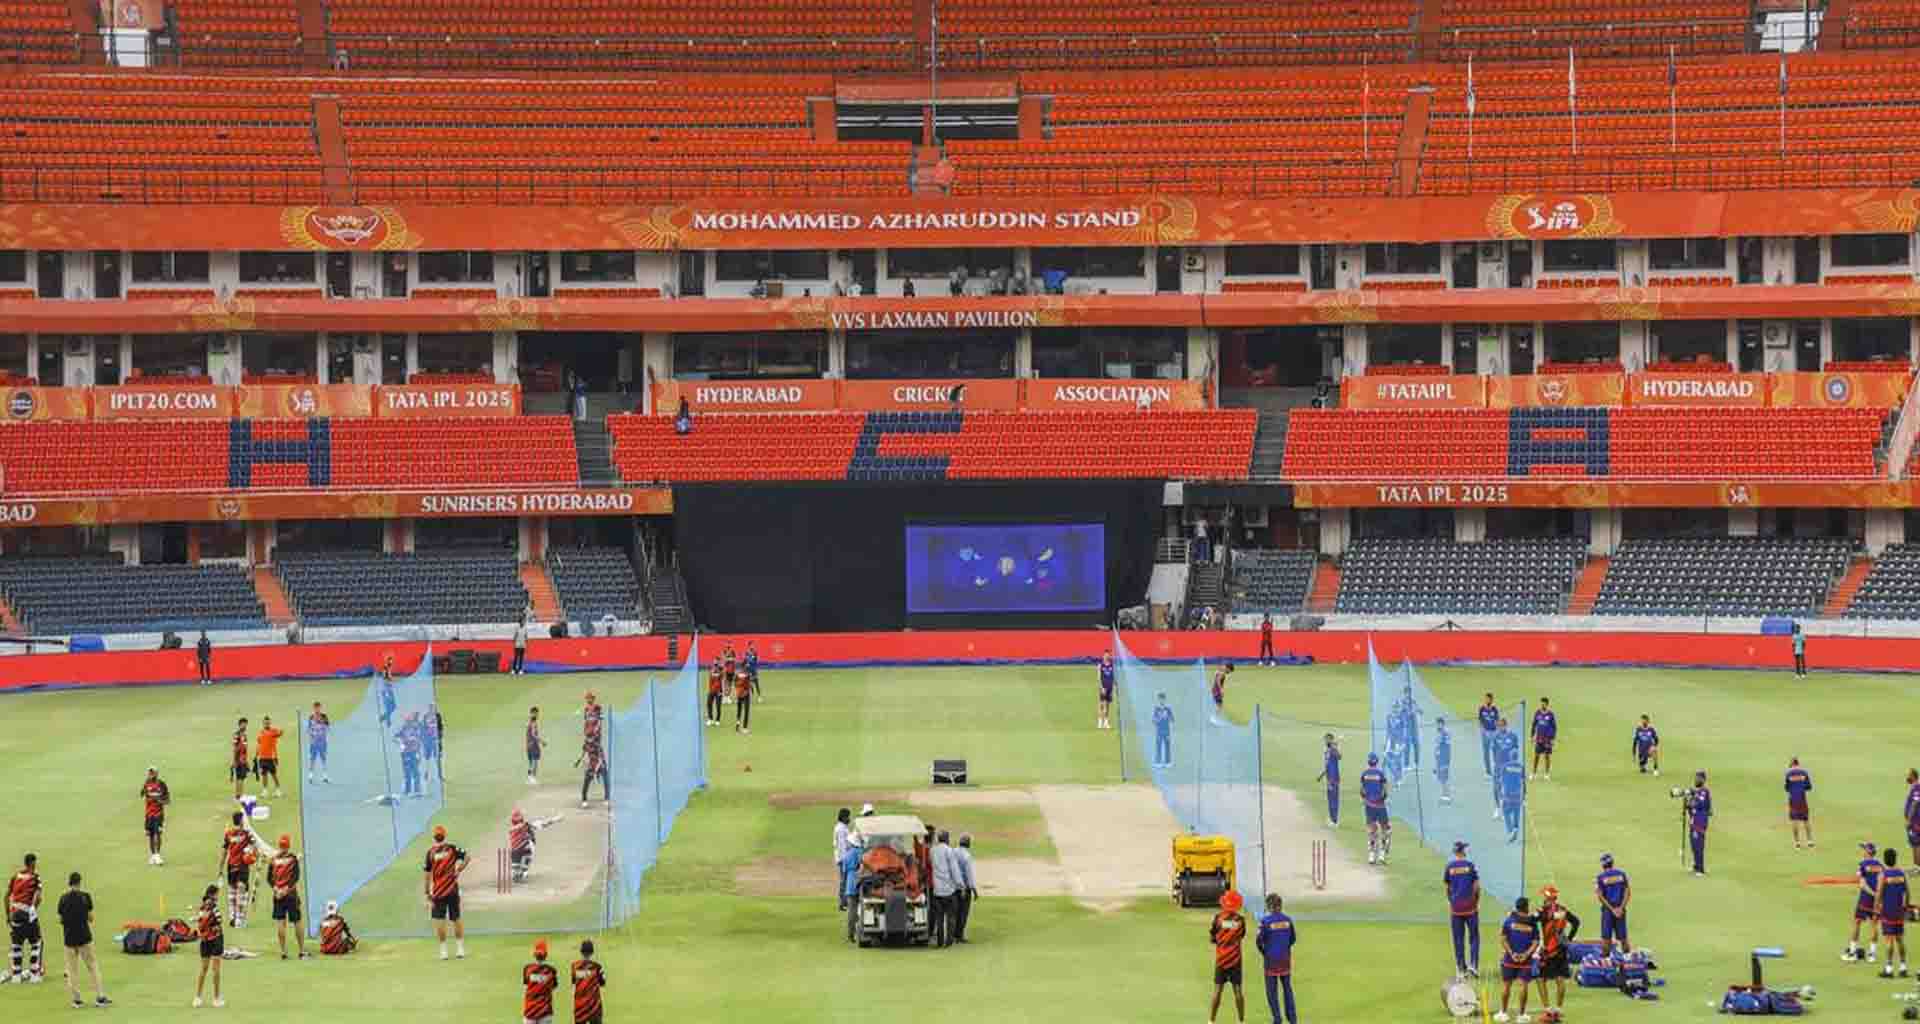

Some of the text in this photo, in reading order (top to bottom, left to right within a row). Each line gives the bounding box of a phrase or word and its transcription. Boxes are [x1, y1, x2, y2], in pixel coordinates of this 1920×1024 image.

[693, 210, 1140, 229] MOHAMMED AZHARUDDIN STAND
[831, 311, 1038, 329] VVS LAXMAN PAVILION
[696, 386, 802, 402] HYDERABAD
[1377, 383, 1456, 400] #TATAIPL
[1643, 380, 1753, 397] HYDERABAD
[111, 392, 217, 409] IPLT20.COM
[385, 391, 512, 408] TATA IPL 2025
[1376, 486, 1508, 502] TATA IPL 2025
[421, 493, 633, 513] SUNRISERS HYDERABAD
